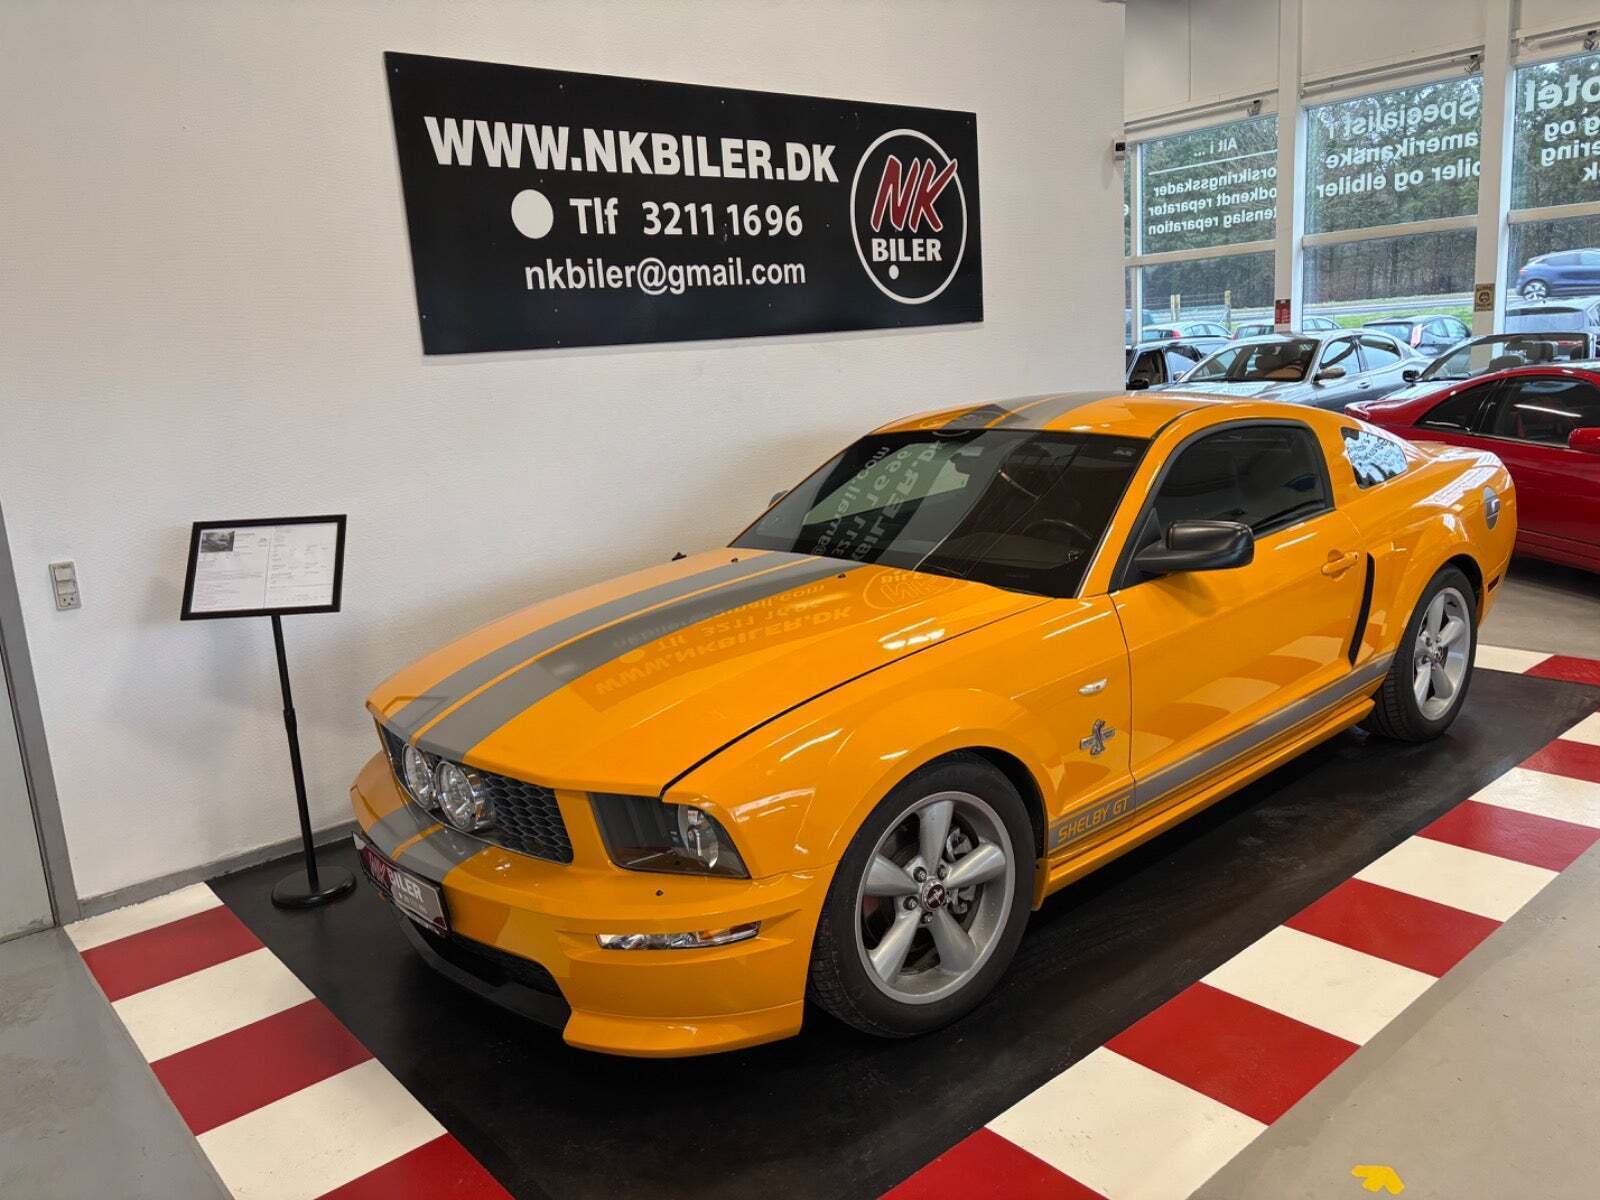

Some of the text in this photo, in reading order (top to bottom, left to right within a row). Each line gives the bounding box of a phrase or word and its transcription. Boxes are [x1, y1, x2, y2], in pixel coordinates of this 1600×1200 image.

[424, 116, 839, 184] WWW.NKBILER.DK
[870, 154, 958, 233] NK
[570, 197, 803, 237] Tlf 3211 1696
[871, 238, 943, 263] BILER
[525, 256, 807, 297] nkbiler@gmail.com
[1058, 795, 1132, 843] SHELBY GT
